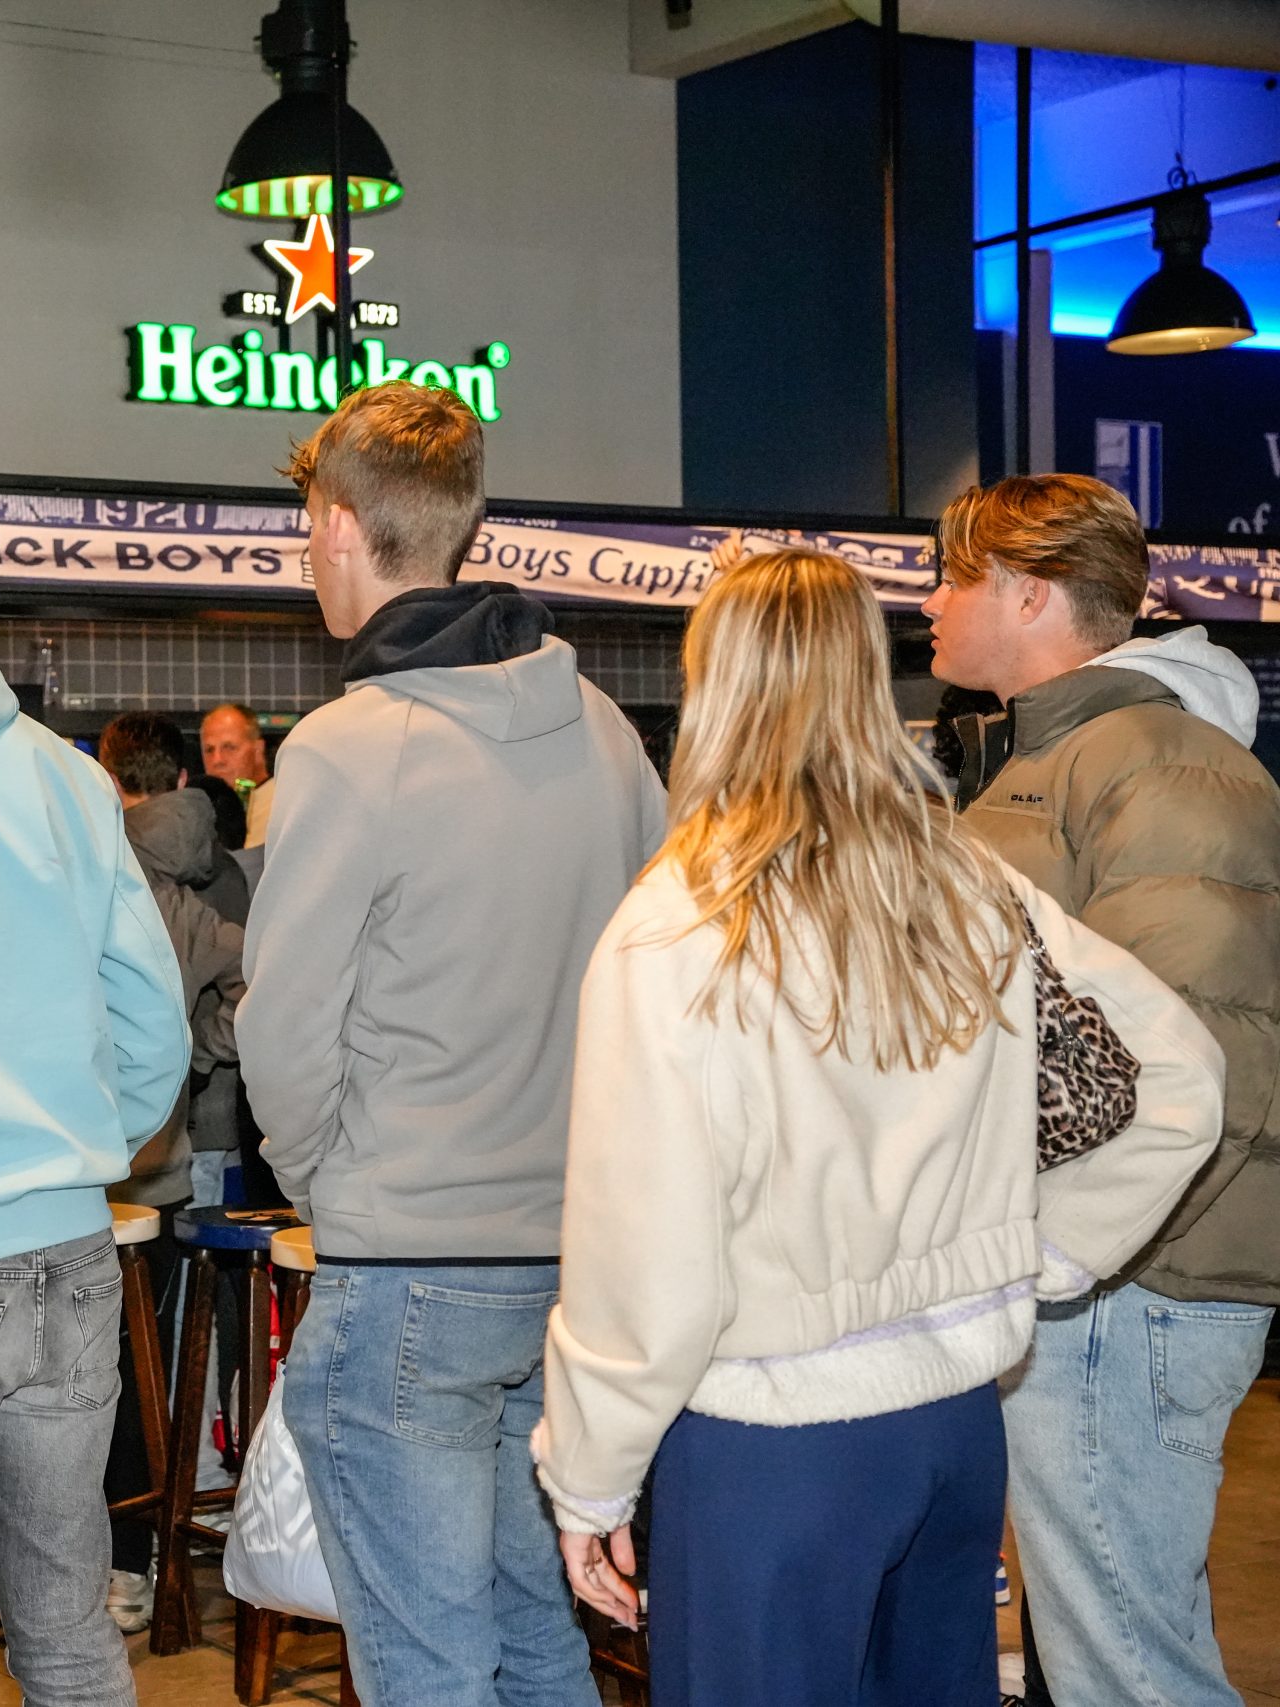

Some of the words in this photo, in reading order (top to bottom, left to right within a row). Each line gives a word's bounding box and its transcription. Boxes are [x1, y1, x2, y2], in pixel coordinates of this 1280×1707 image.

[242, 292, 281, 316] EST.
[358, 302, 399, 326] 1873
[114, 541, 283, 575] BOYS
[465, 531, 572, 581] Boys
